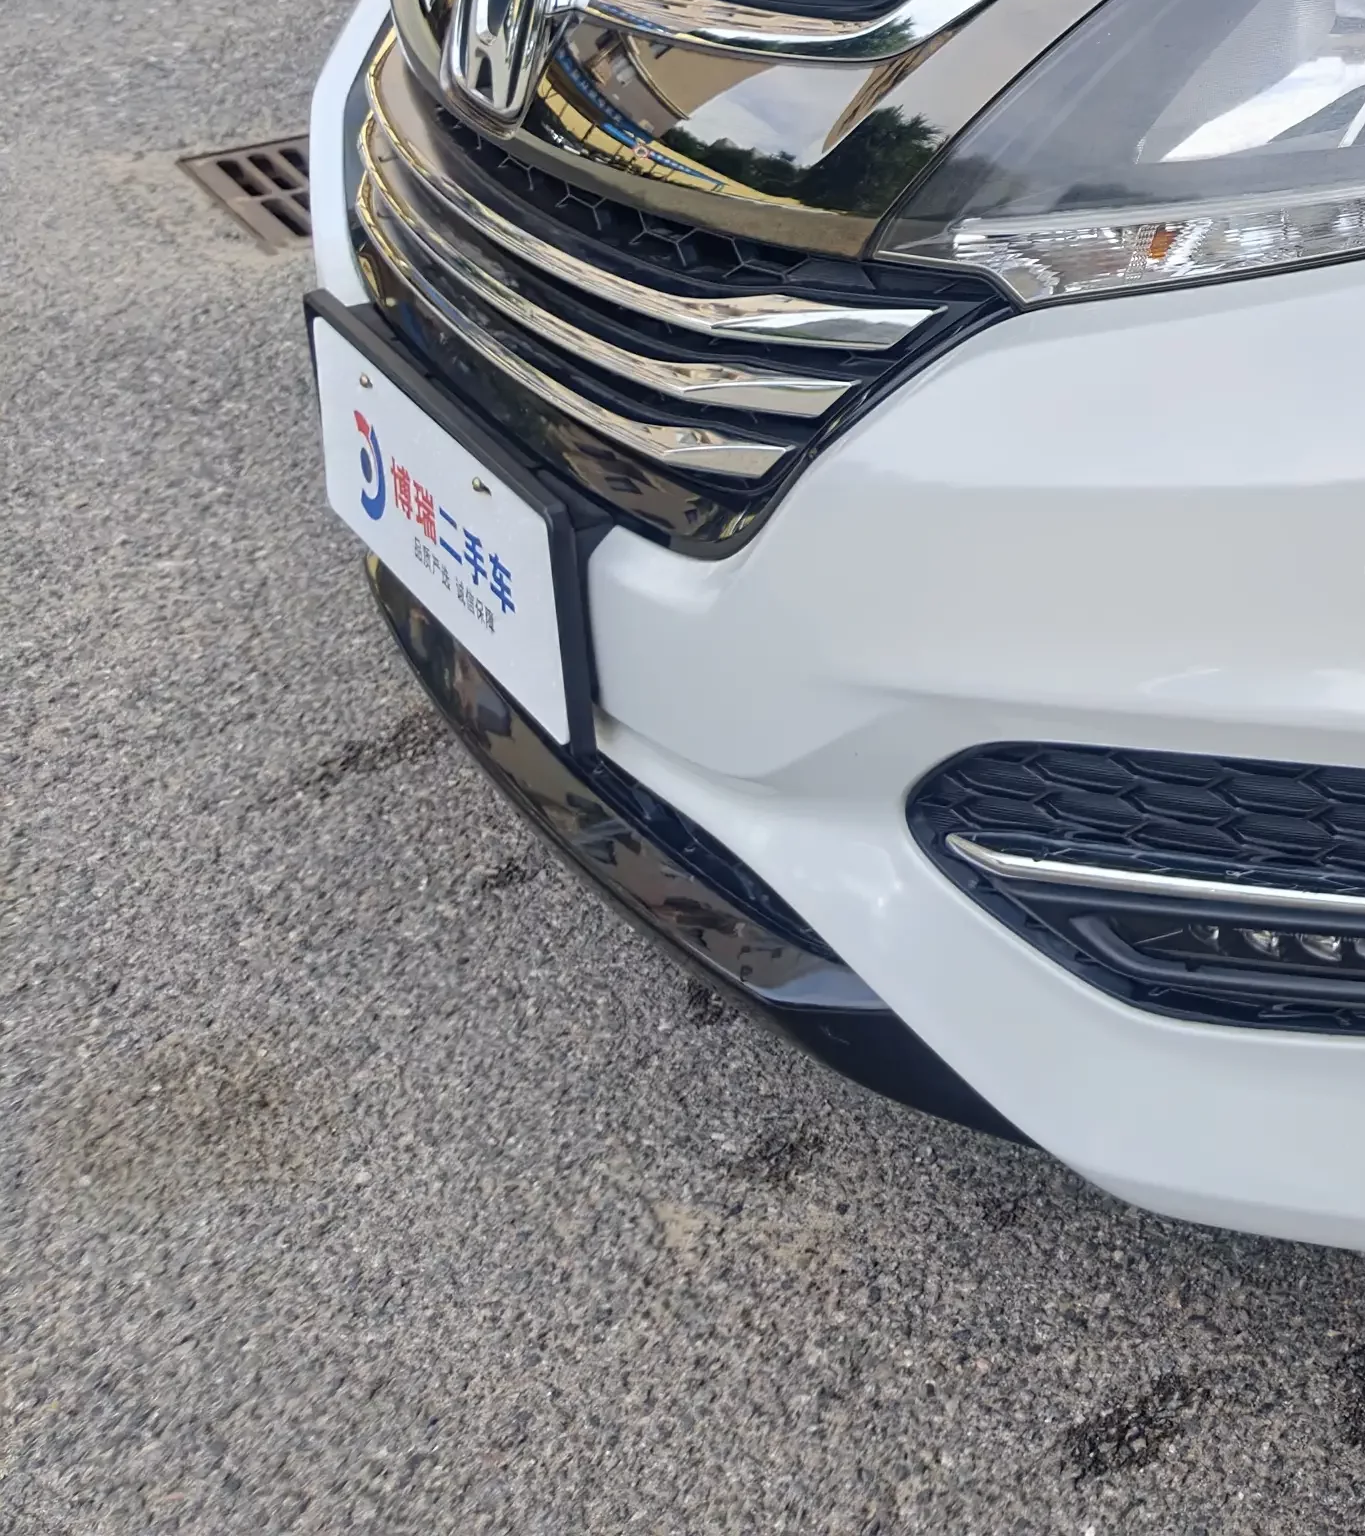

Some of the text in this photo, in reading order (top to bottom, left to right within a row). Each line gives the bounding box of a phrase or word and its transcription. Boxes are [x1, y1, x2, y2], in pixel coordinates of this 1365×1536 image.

[390, 456, 515, 614] 博瑞二手车
